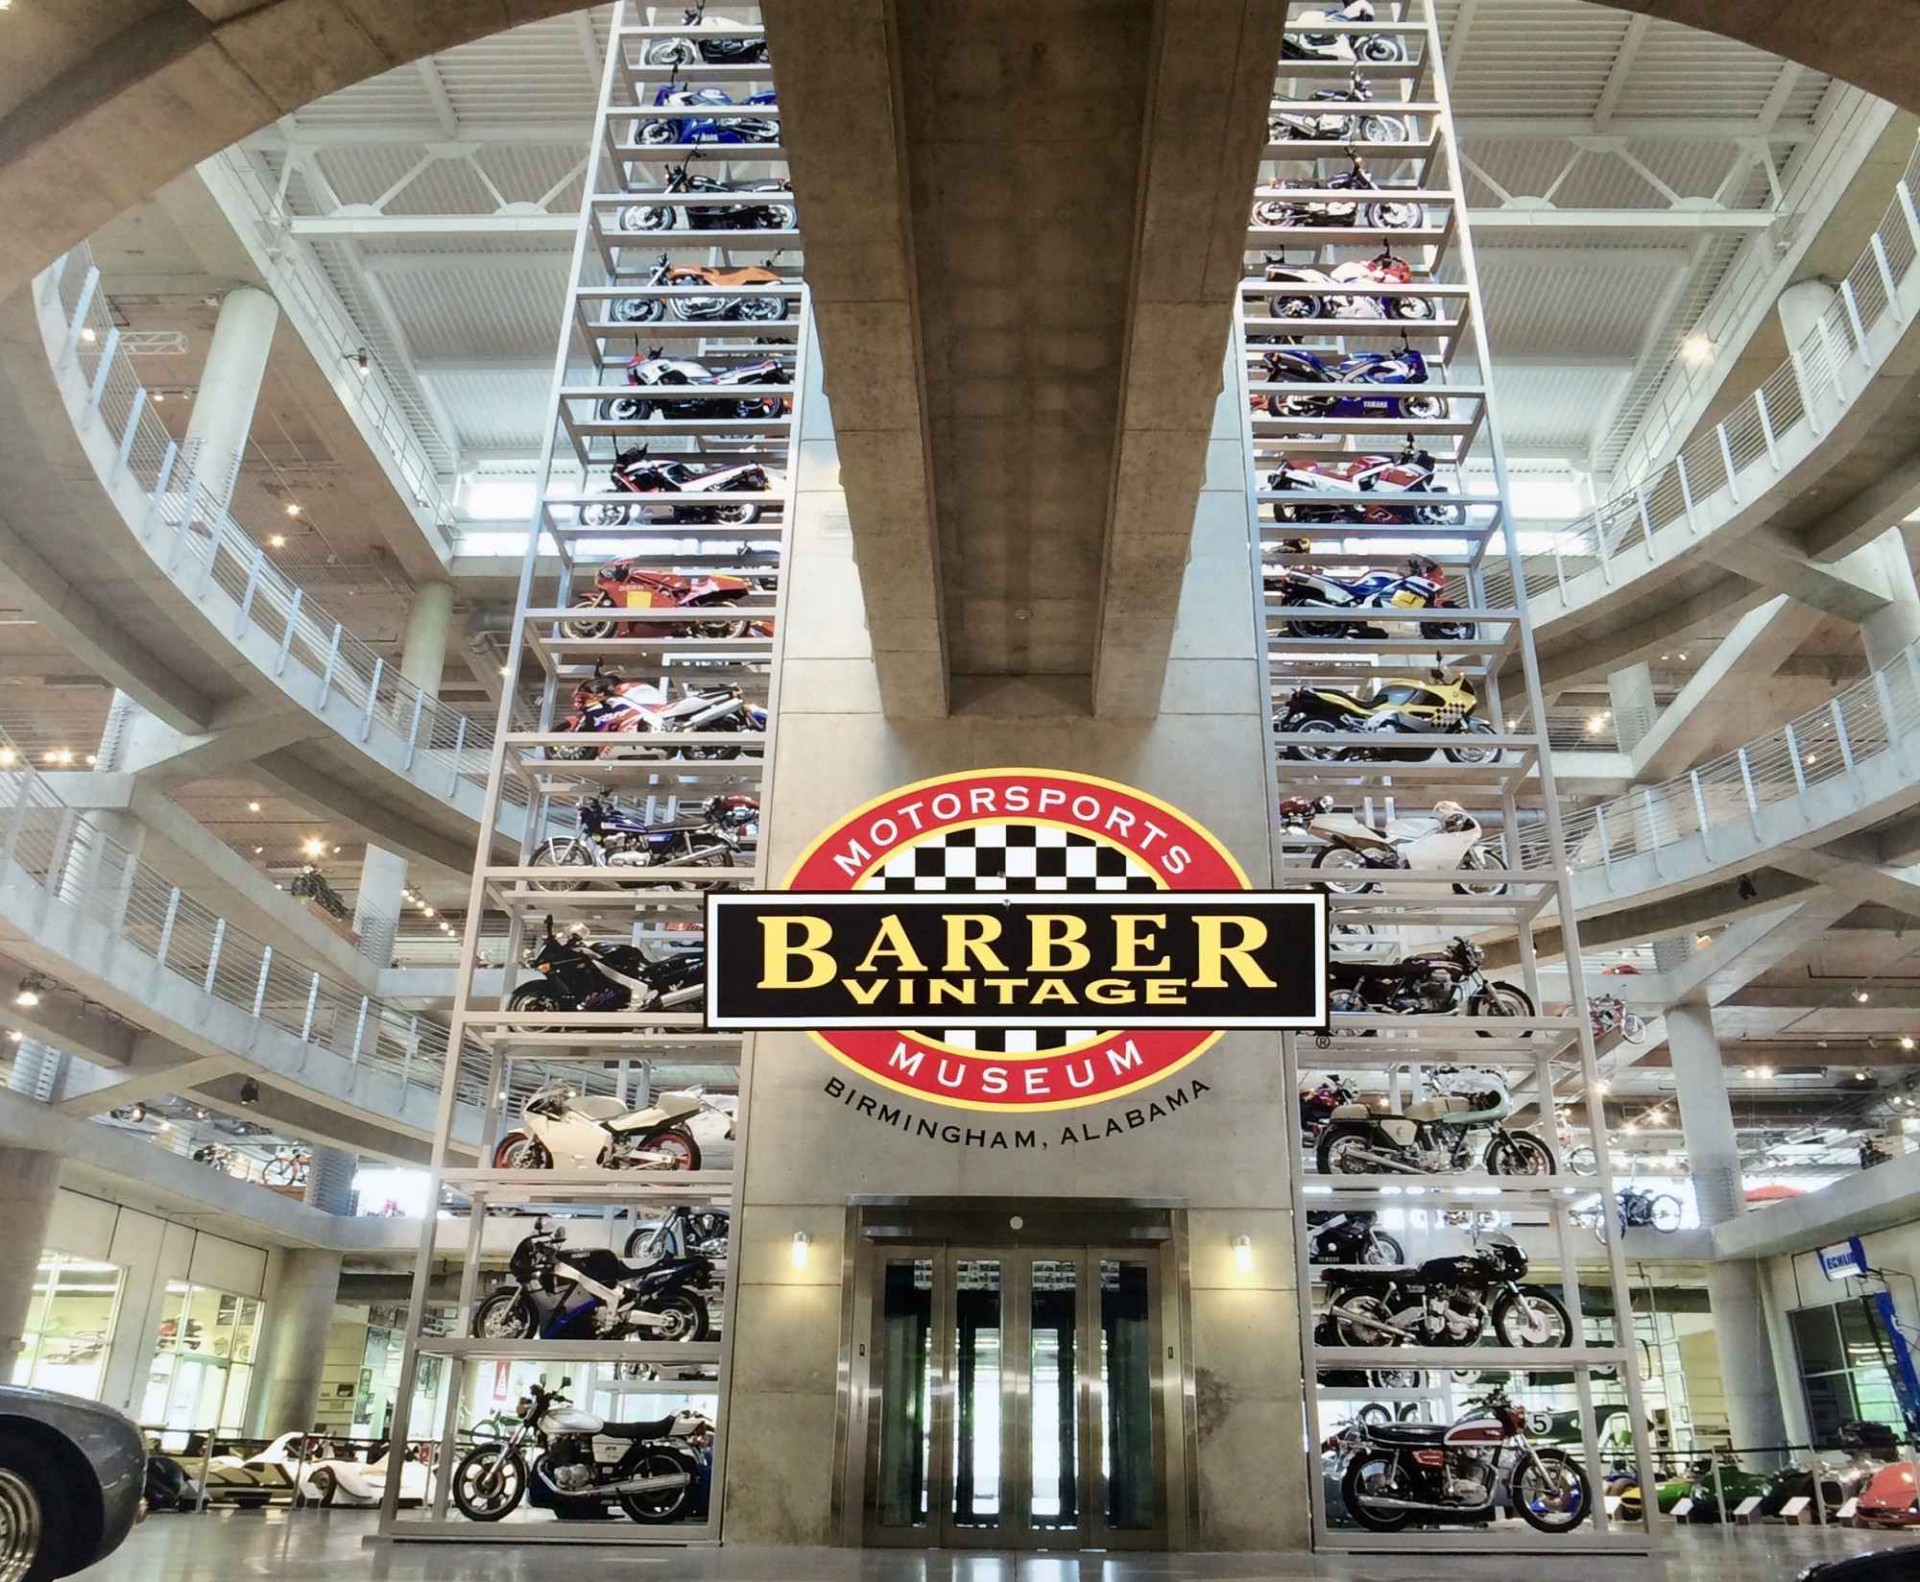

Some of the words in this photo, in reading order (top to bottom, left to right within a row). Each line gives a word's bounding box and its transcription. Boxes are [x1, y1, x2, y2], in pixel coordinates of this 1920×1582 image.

[832, 785, 1192, 877] MOTORSPORTS
[756, 913, 1278, 990] BARBER
[841, 978, 1188, 1005] VINTAGE
[888, 1039, 1144, 1095] MUSEUM
[824, 1076, 1048, 1149] BIRMINGHAM,
[1060, 1079, 1212, 1145] ALABAMA
[1533, 1414, 1547, 1433] 5
